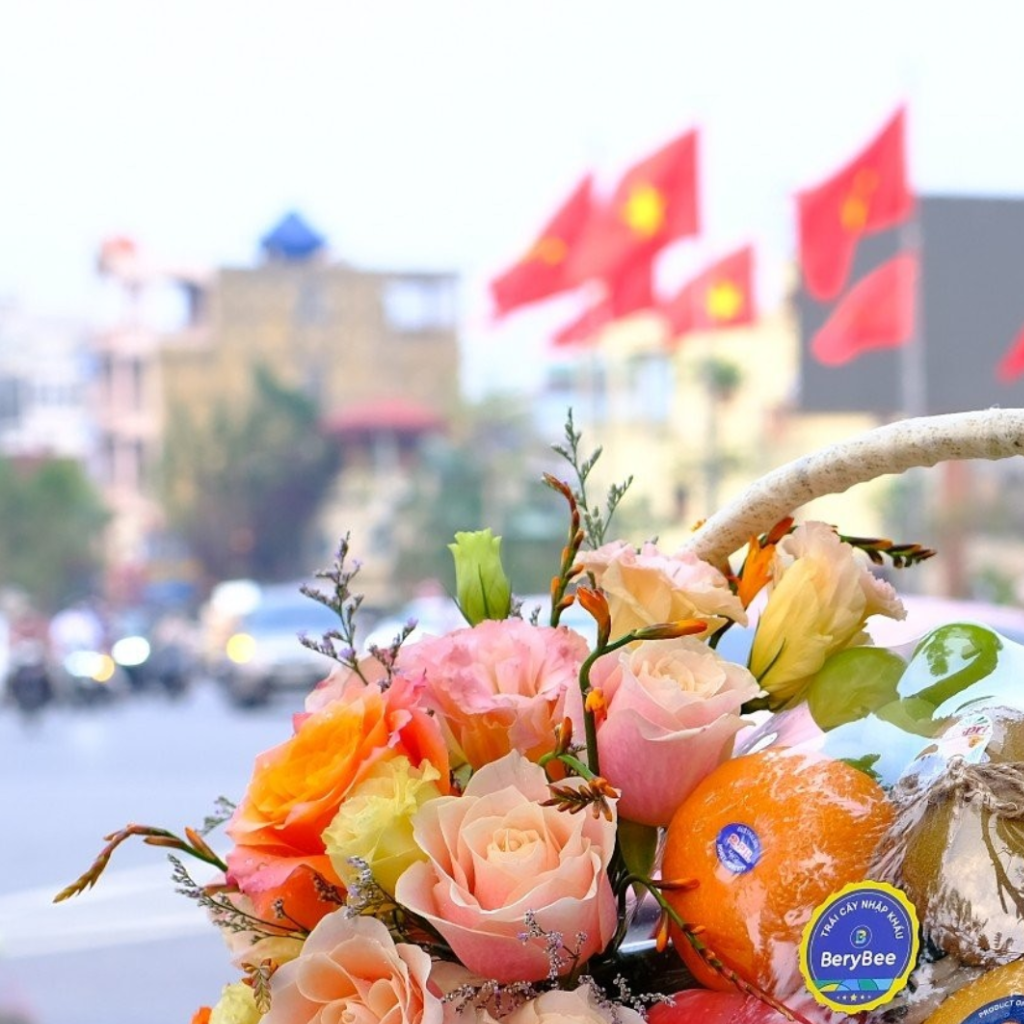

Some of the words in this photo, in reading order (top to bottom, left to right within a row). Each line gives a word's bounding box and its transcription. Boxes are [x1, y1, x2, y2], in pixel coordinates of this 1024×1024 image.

[820, 914, 839, 938] TRÁI
[839, 900, 858, 916] CÂY
[861, 899, 889, 914] NHẬP
[820, 950, 897, 971] BeryBee
[978, 1000, 1014, 1018] PRODUCT
[1015, 999, 1024, 1007] OF
